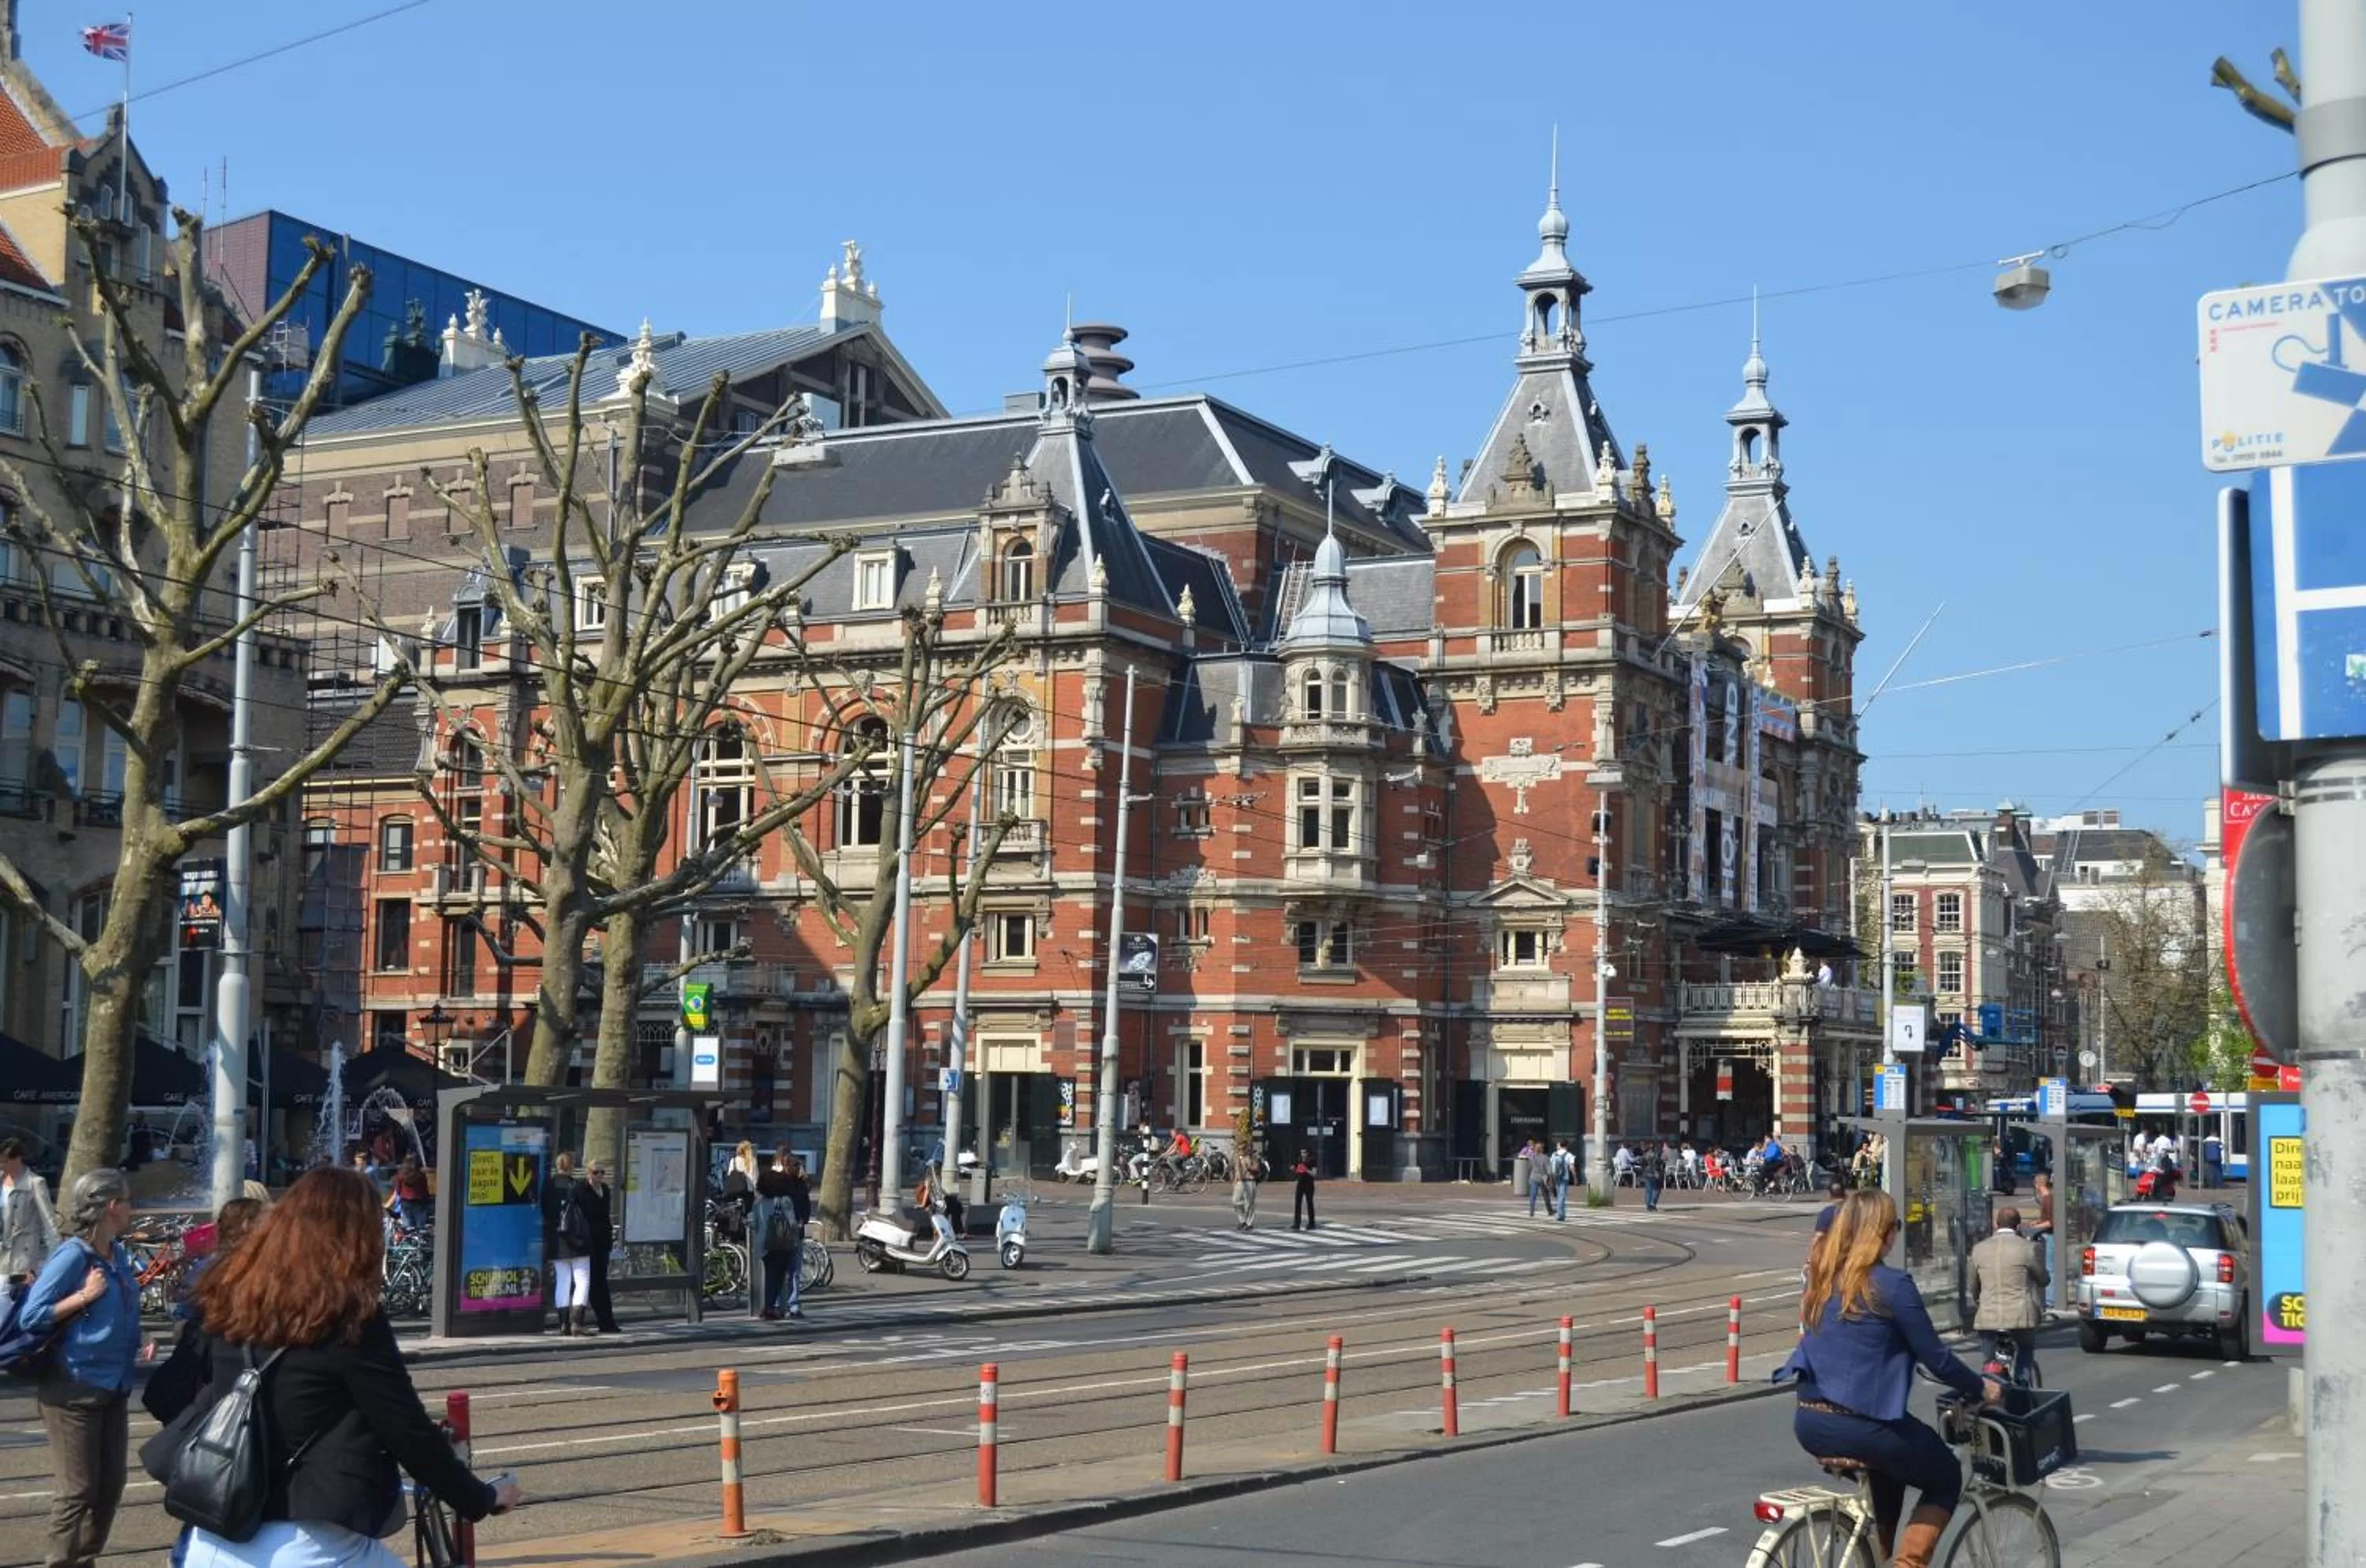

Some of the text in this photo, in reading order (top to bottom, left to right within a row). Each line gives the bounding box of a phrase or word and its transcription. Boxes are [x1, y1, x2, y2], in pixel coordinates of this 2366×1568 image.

[2208, 286, 2366, 320] CAMERA TO
[2211, 431, 2283, 452] POLITIE
[1722, 681, 1738, 901] HOLAND
